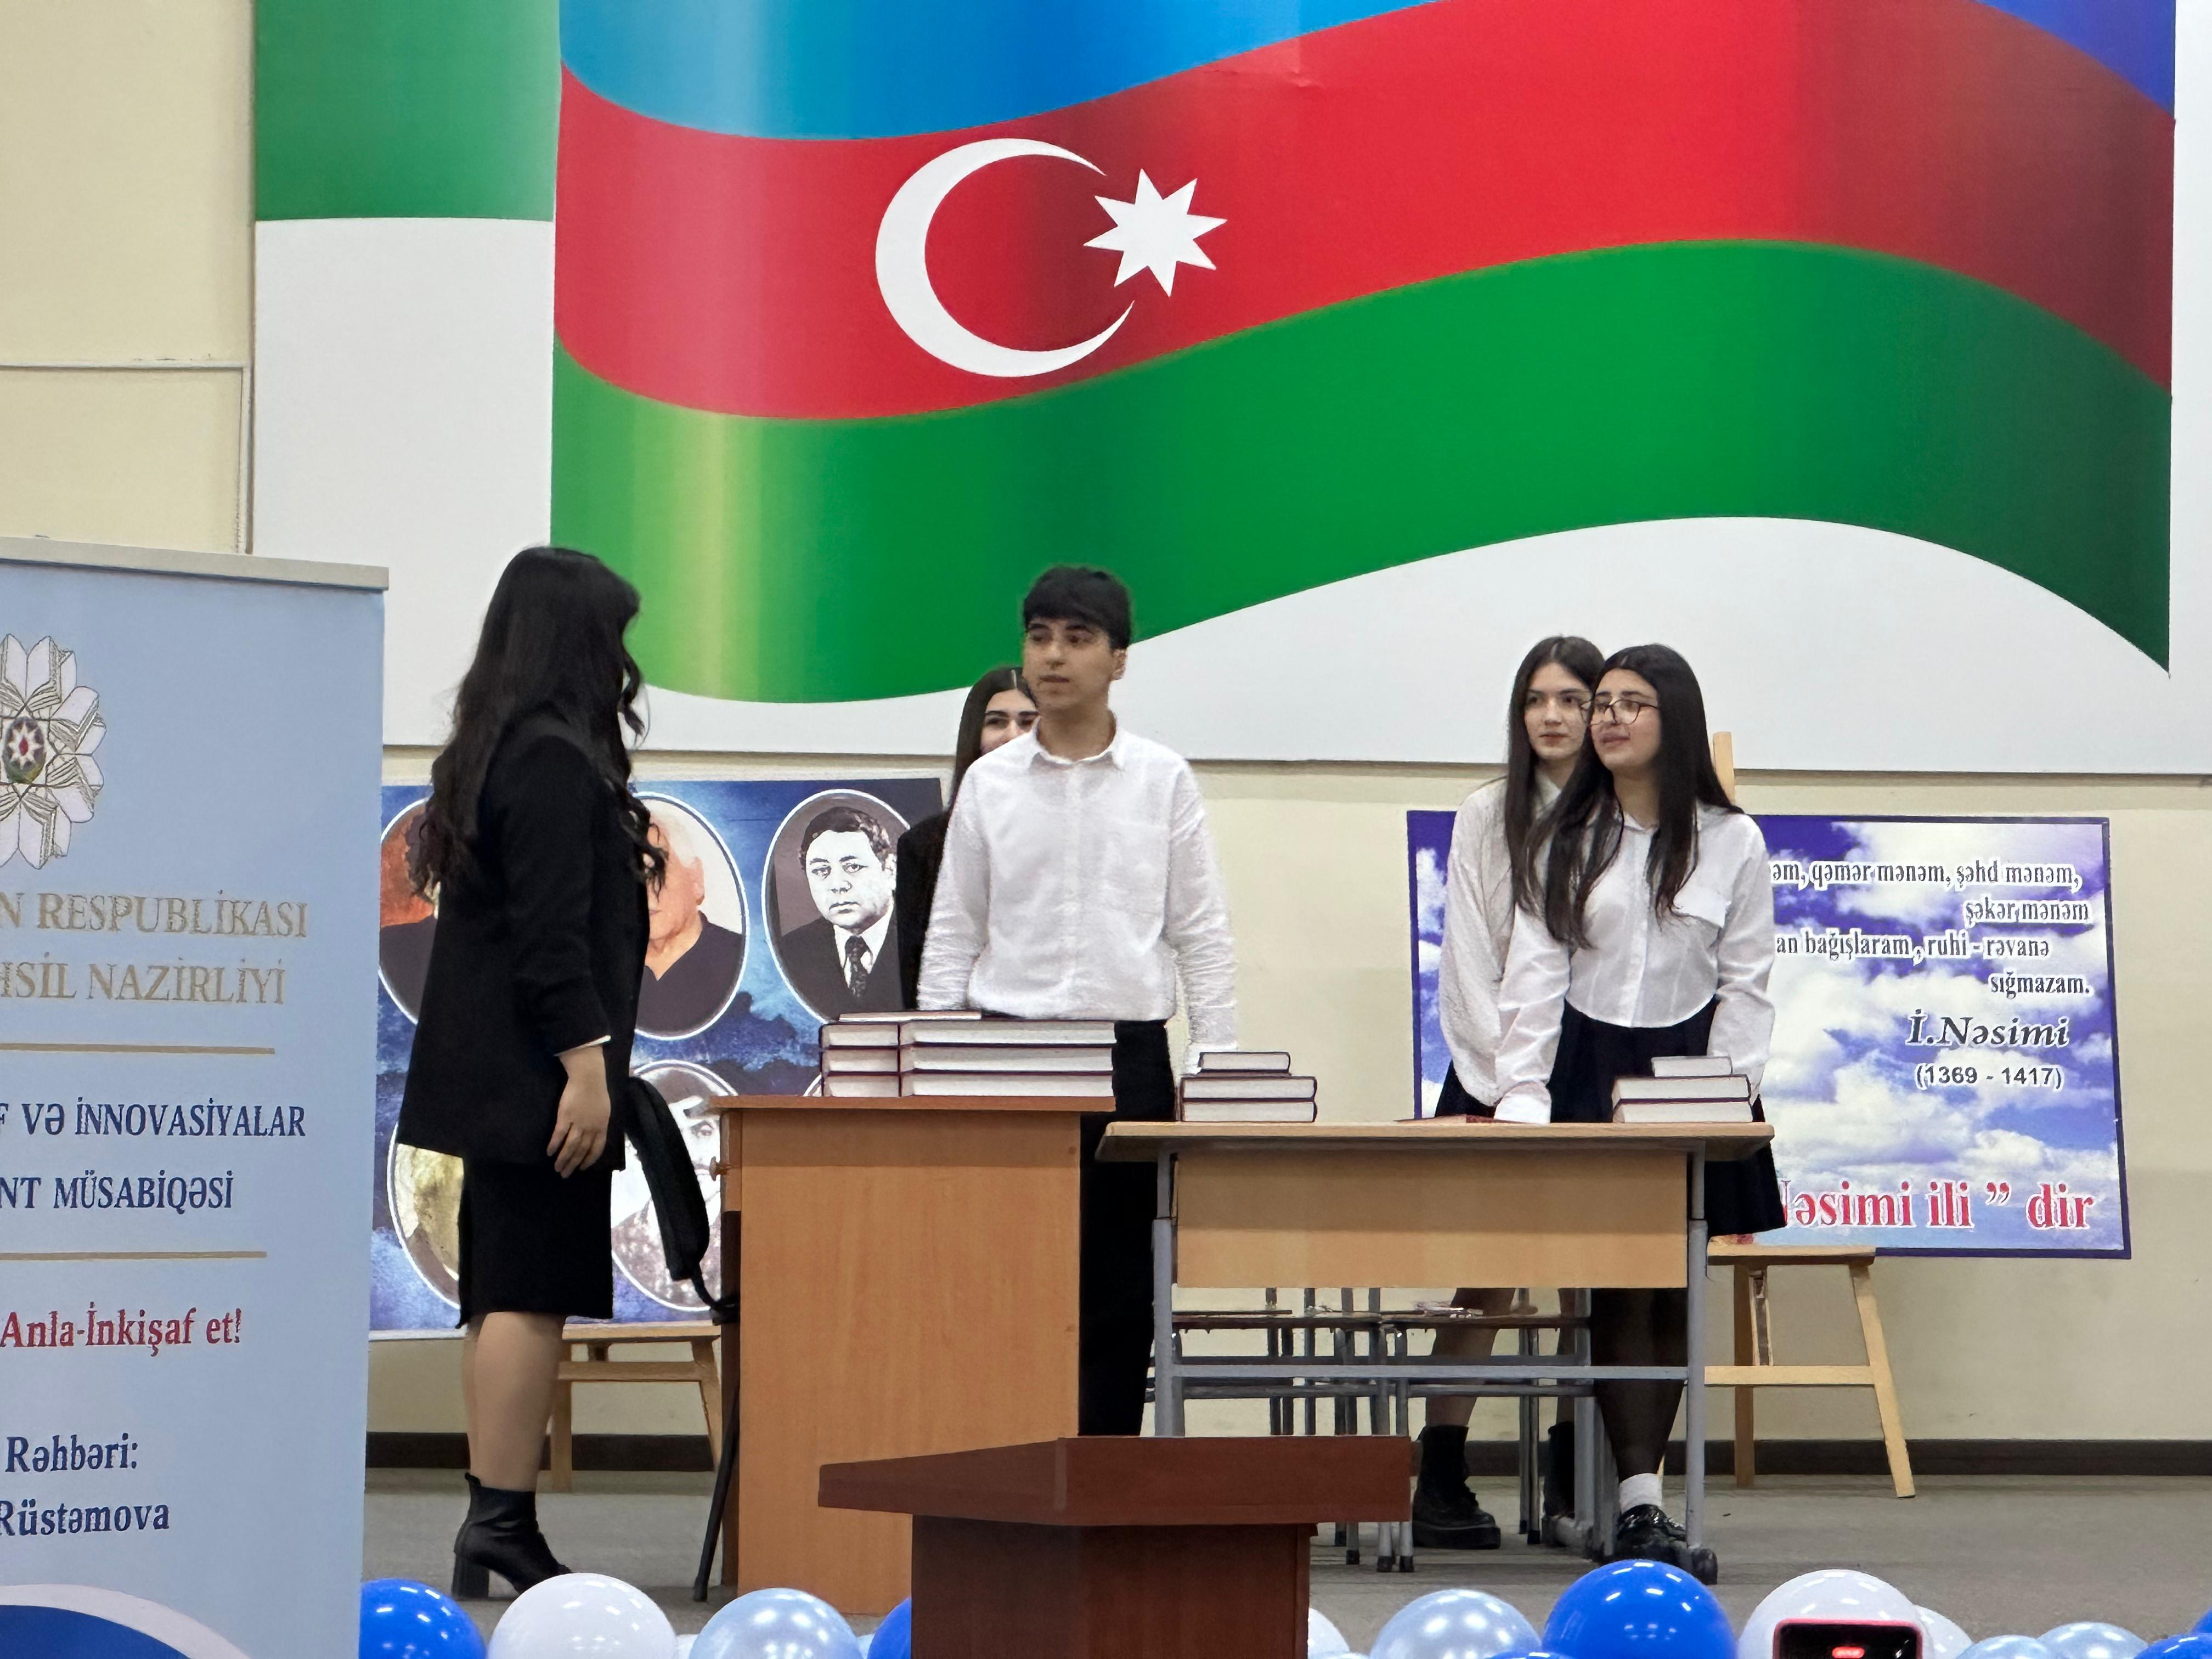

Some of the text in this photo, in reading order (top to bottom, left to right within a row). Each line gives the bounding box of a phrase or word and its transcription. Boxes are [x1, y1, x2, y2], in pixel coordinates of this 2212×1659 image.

[1956, 860, 1999, 889] şəhd
[2005, 866, 2080, 890] mənəm,
[37, 889, 308, 938] RESPUBLİKASI
[1928, 932, 1967, 956] ruhi
[1987, 939, 2050, 957] rəvanə
[86, 957, 286, 1005] NAZİRLİYİ
[1990, 971, 2090, 1000] sığmazam.
[1905, 1008, 2069, 1045] İ.Nəsimi
[1916, 1064, 1978, 1088] (1369
[2001, 1066, 2063, 1090] 1417)
[21, 1103, 65, 1135] VƏ
[75, 1097, 306, 1137] İNNOVASİYALAR
[53, 1169, 234, 1215] MÜSABİQƏSİ
[1929, 1181, 1971, 1227] ili
[2028, 1183, 2095, 1228] dir
[0, 1301, 242, 1357] Anla-İnkişaf et!
[4, 1432, 138, 1472] Rəhbəri:
[0, 1498, 170, 1536] Rüstəmova
